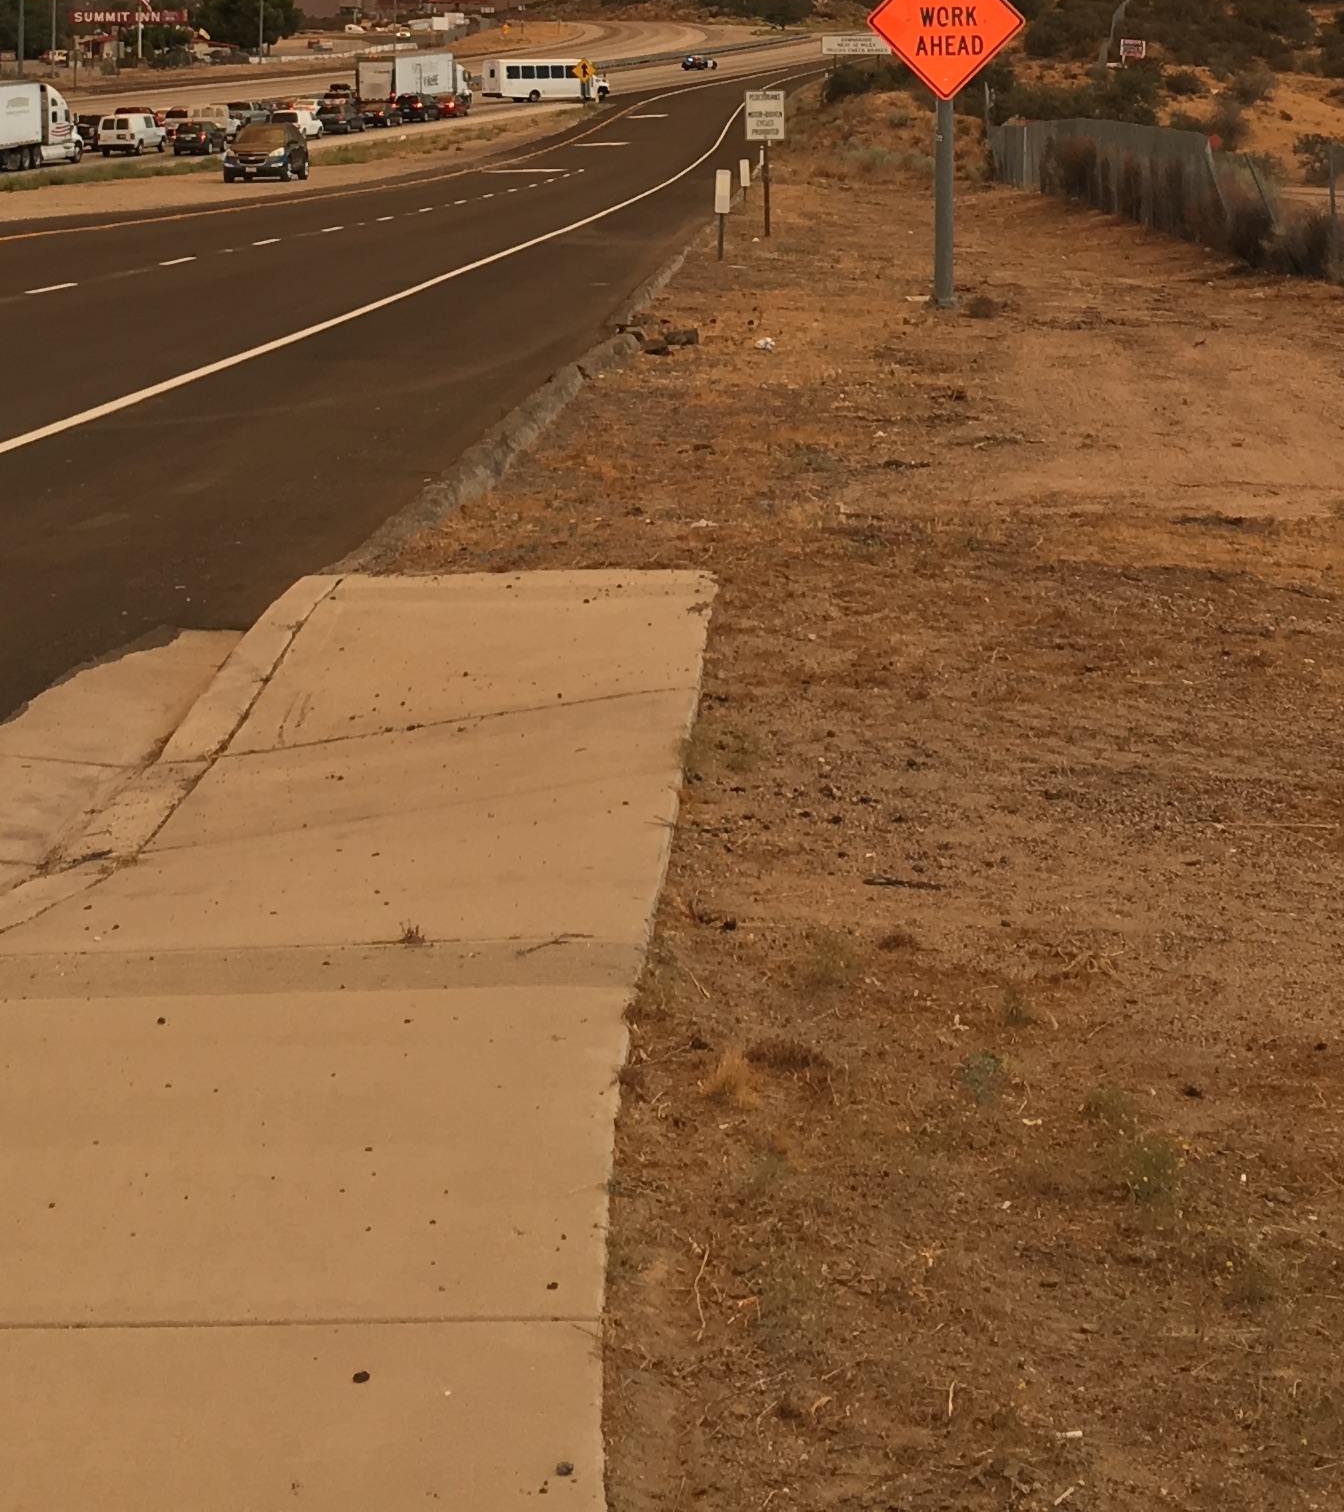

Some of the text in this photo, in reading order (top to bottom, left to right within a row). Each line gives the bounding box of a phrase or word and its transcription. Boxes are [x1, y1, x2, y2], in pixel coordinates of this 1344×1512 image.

[74, 11, 131, 22] SUMMIT
[135, 11, 161, 22] INN
[920, 6, 977, 27] WORK
[915, 35, 984, 56] AHEAD
